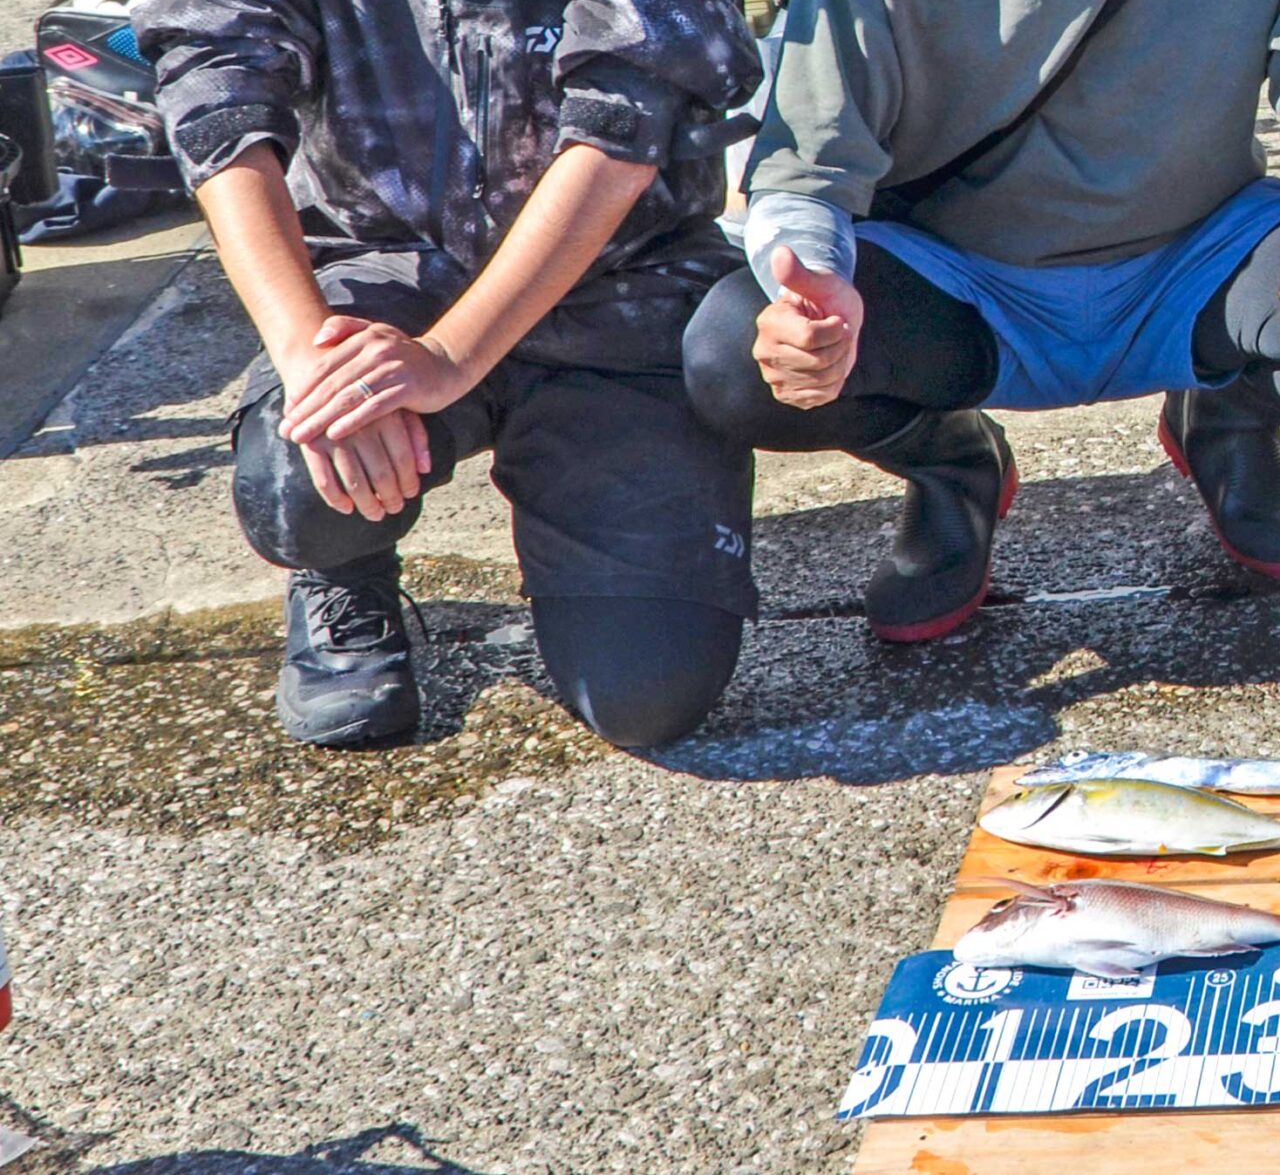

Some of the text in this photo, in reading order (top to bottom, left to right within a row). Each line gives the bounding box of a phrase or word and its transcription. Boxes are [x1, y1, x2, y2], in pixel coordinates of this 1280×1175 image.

[1211, 972, 1228, 984] 25
[942, 992, 1004, 1006] MARINA
[966, 1008, 1024, 1113] 1
[1070, 1003, 1193, 1110] 2
